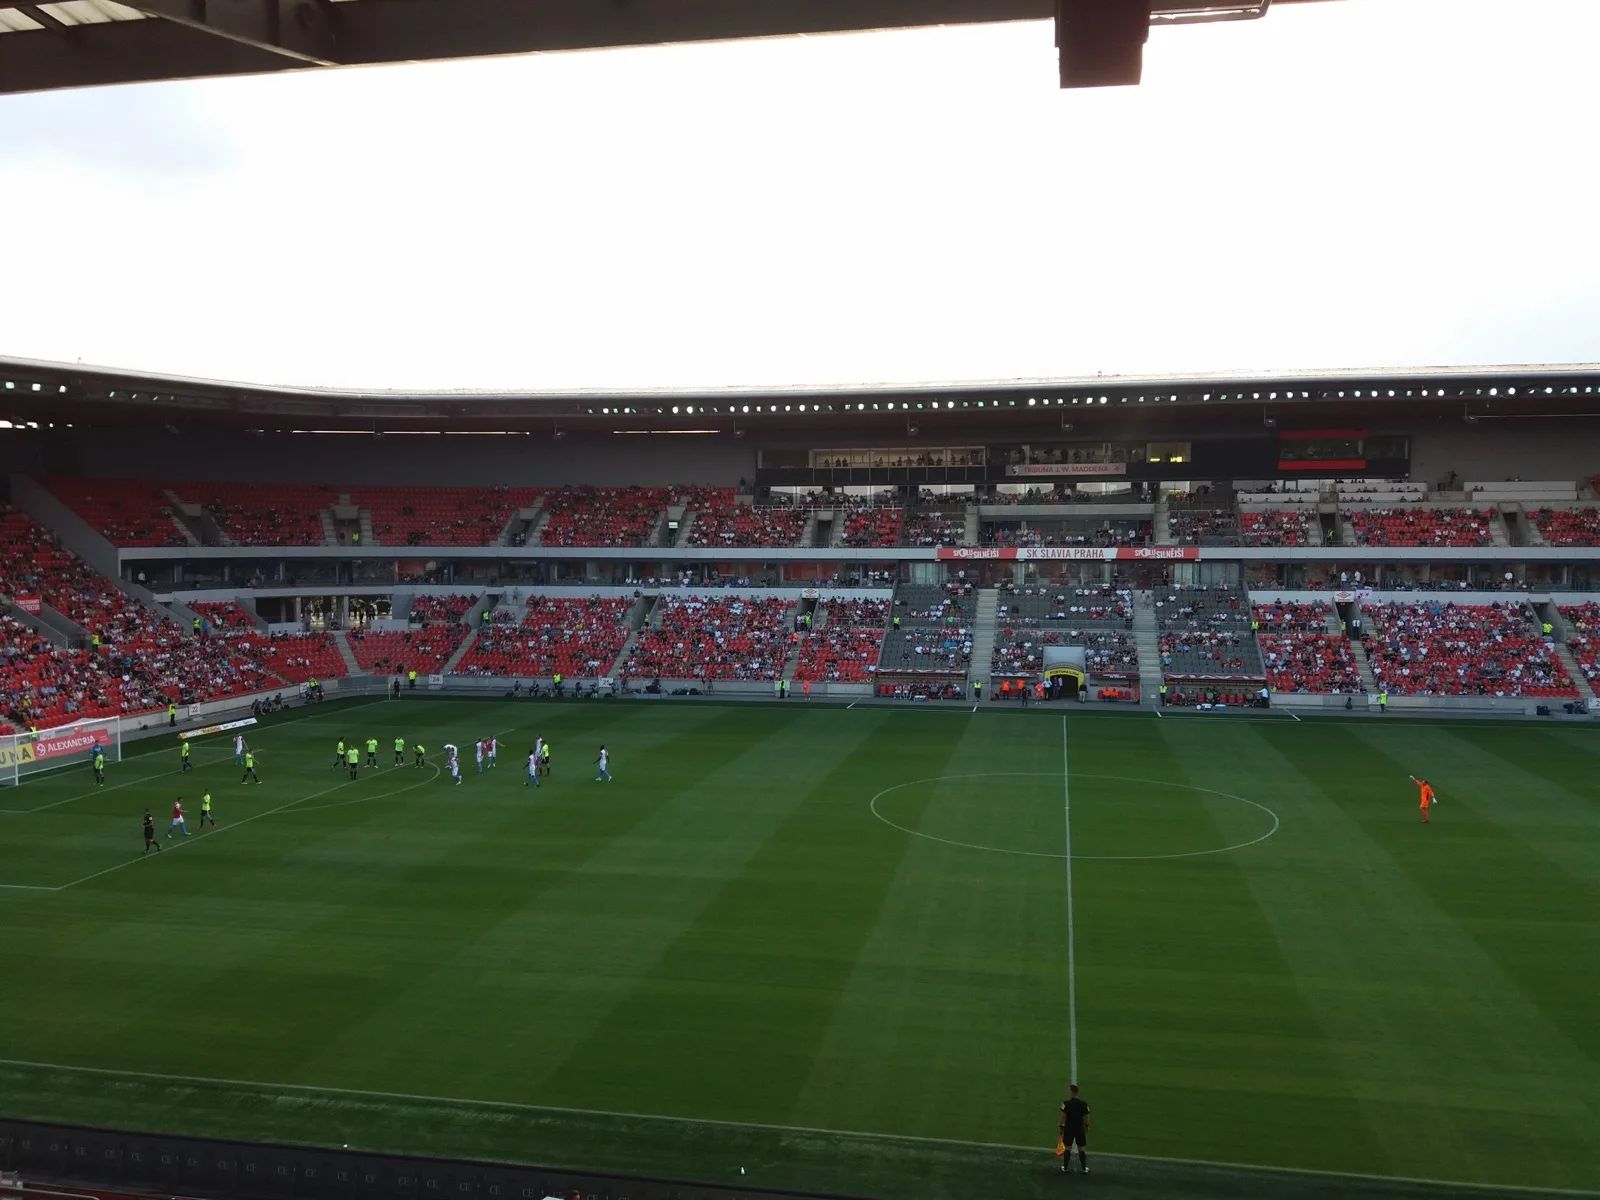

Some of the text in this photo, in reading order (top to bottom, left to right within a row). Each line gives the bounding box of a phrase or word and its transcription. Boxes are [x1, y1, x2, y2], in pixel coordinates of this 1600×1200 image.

[1071, 464, 1108, 472] MADDENA
[1027, 548, 1104, 558] SK SLAVIA PRAHA
[48, 735, 96, 752] ALEXANDRIA
